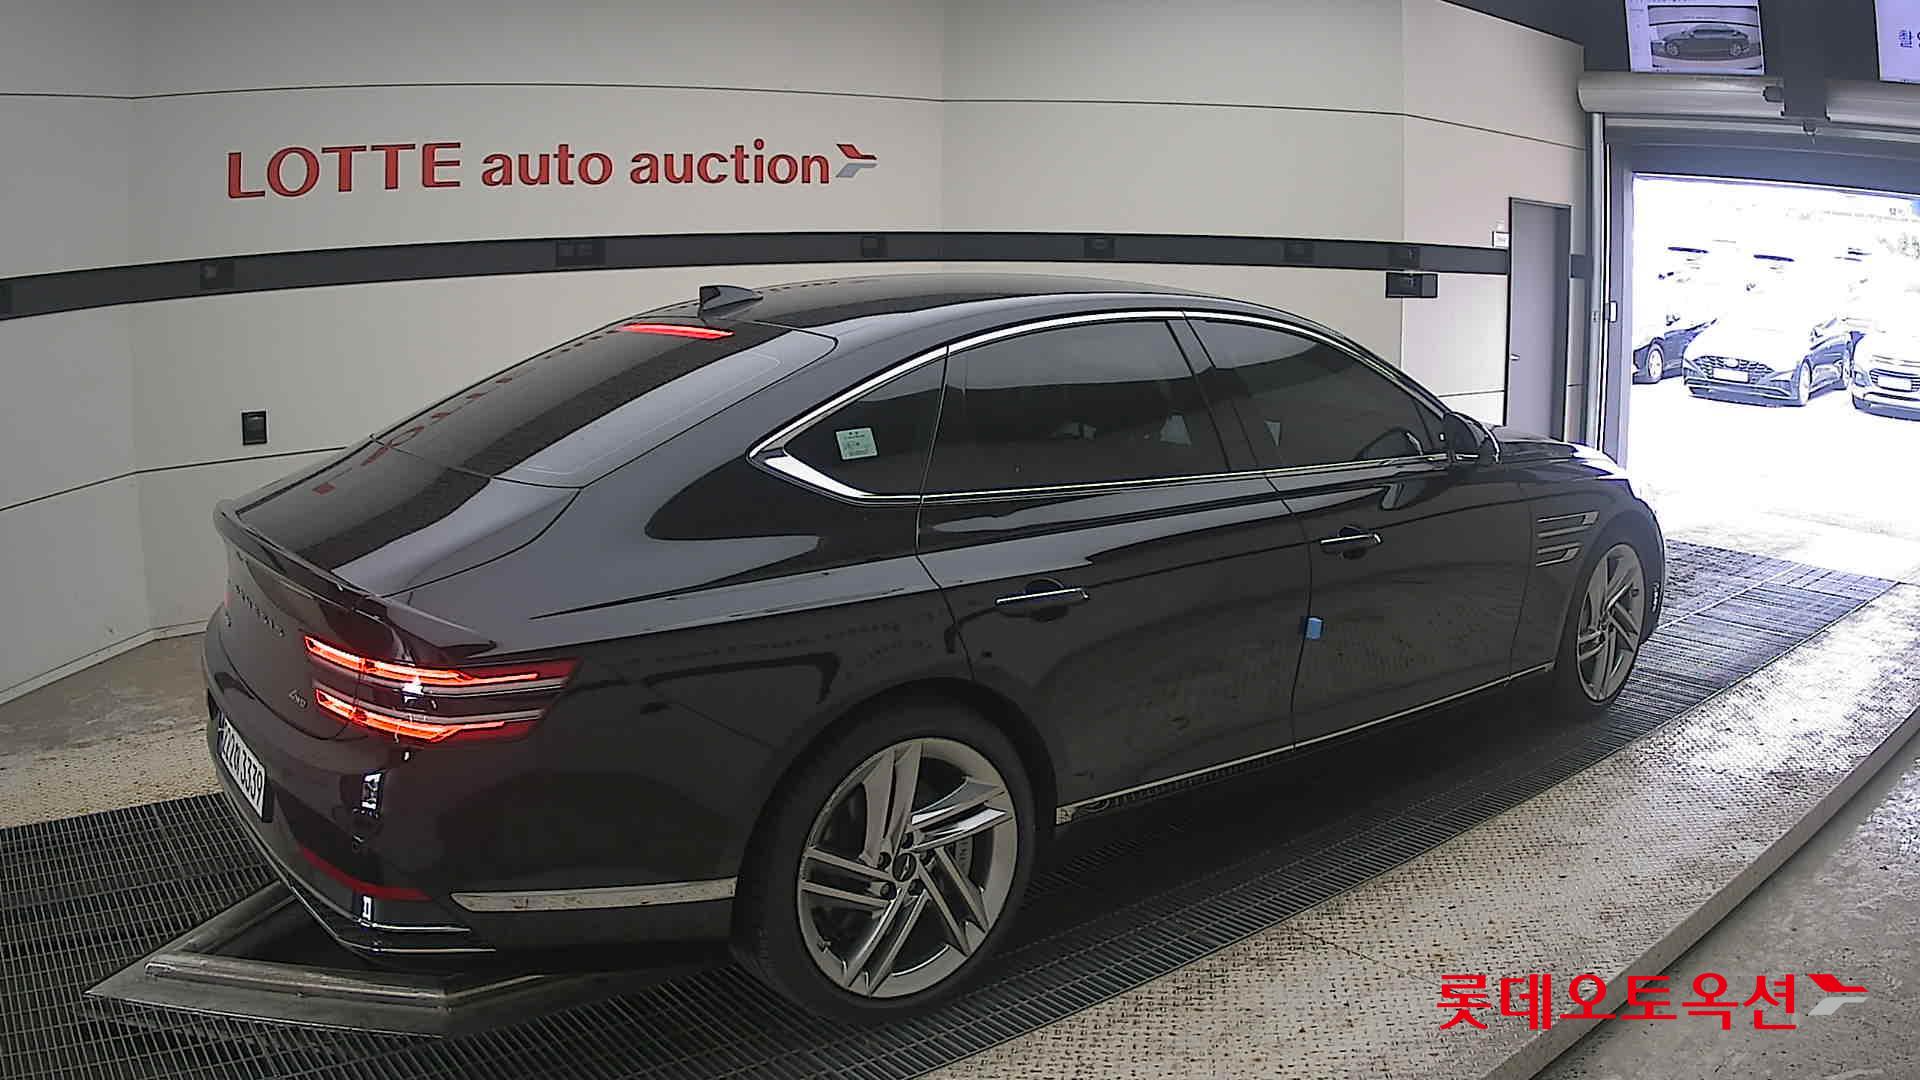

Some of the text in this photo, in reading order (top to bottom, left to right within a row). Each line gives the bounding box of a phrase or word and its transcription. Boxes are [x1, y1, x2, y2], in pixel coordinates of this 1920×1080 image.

[228, 138, 831, 198] LOTTE auto auction
